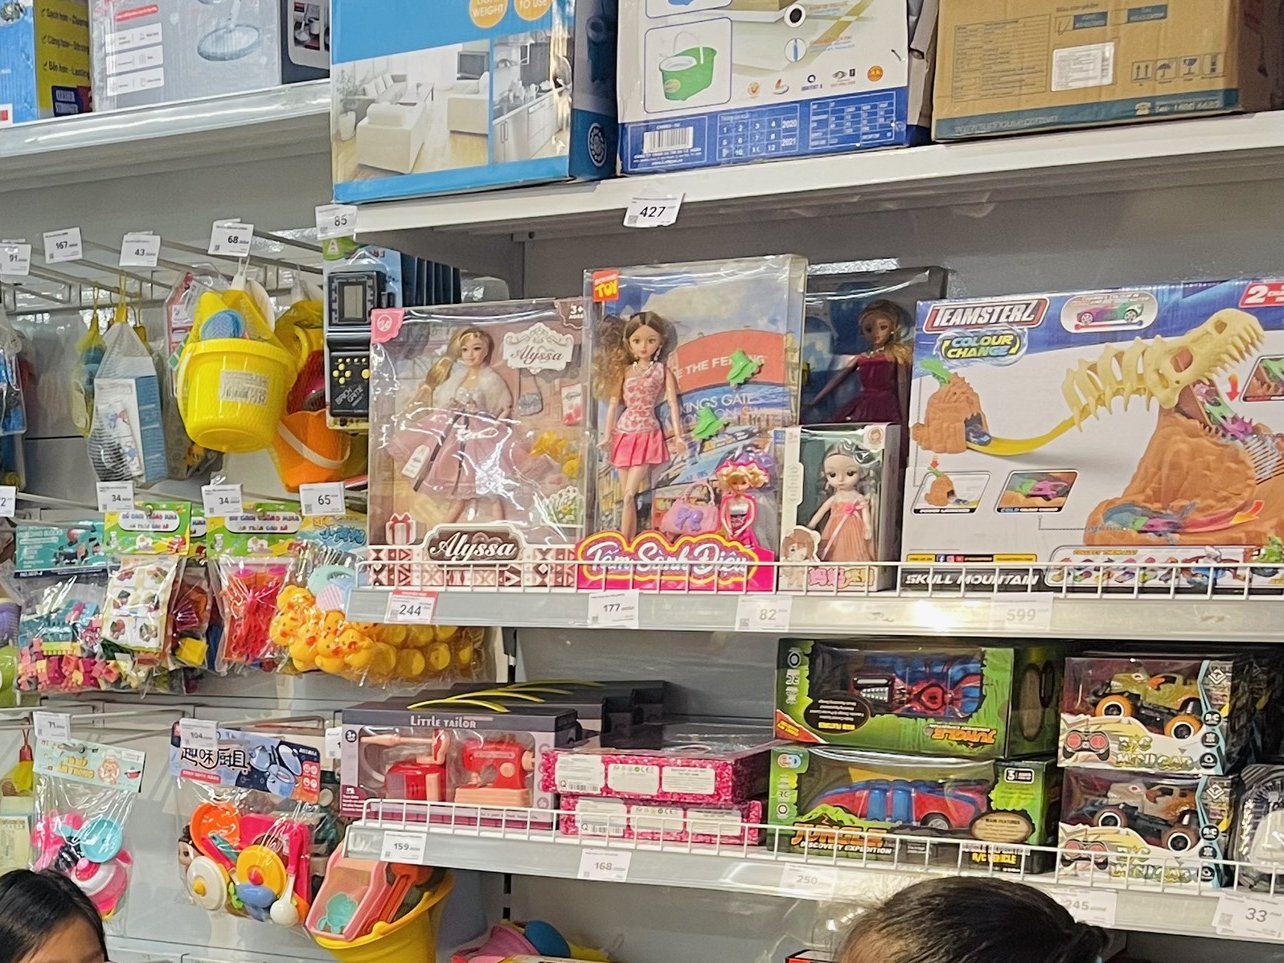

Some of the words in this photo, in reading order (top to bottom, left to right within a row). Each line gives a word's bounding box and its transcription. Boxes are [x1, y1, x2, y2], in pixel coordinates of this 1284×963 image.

[473, 4, 505, 17] WEIGHT
[782, 119, 797, 129] 2020
[639, 206, 666, 218] 427
[334, 215, 347, 227] 85
[228, 235, 239, 244] 68
[9, 254, 18, 263] 91
[134, 249, 145, 257] 43
[595, 280, 618, 297] TOY
[935, 298, 1041, 328] TEAMSTERZ
[950, 334, 1015, 350] COLOUR
[509, 345, 565, 364] Alyssa
[946, 344, 1011, 360] CHANGE
[685, 360, 710, 375] THE
[720, 393, 755, 406] GATE
[112, 494, 121, 502] 34
[219, 497, 229, 505] 34
[318, 494, 331, 506] 65
[429, 531, 517, 565] Alyssa
[586, 541, 633, 571] Tấm
[636, 542, 691, 573] Sành
[693, 541, 748, 578] Điệu
[904, 573, 959, 586] SKULL
[959, 573, 1040, 586] MOUNTAIN
[399, 604, 421, 616] 244
[603, 603, 621, 613] 177
[759, 608, 776, 621] 82
[1006, 608, 1036, 621] 599
[190, 731, 203, 740] 104
[931, 728, 998, 744] JUNGLE
[790, 822, 888, 848] JUNGLE
[394, 842, 410, 851] 159
[800, 841, 844, 852] DISCOVERY
[844, 844, 893, 855] EXPEDITION
[595, 862, 613, 871] 168
[796, 874, 818, 886] 250
[1065, 899, 1090, 912] 245
[1244, 907, 1268, 923] 33
